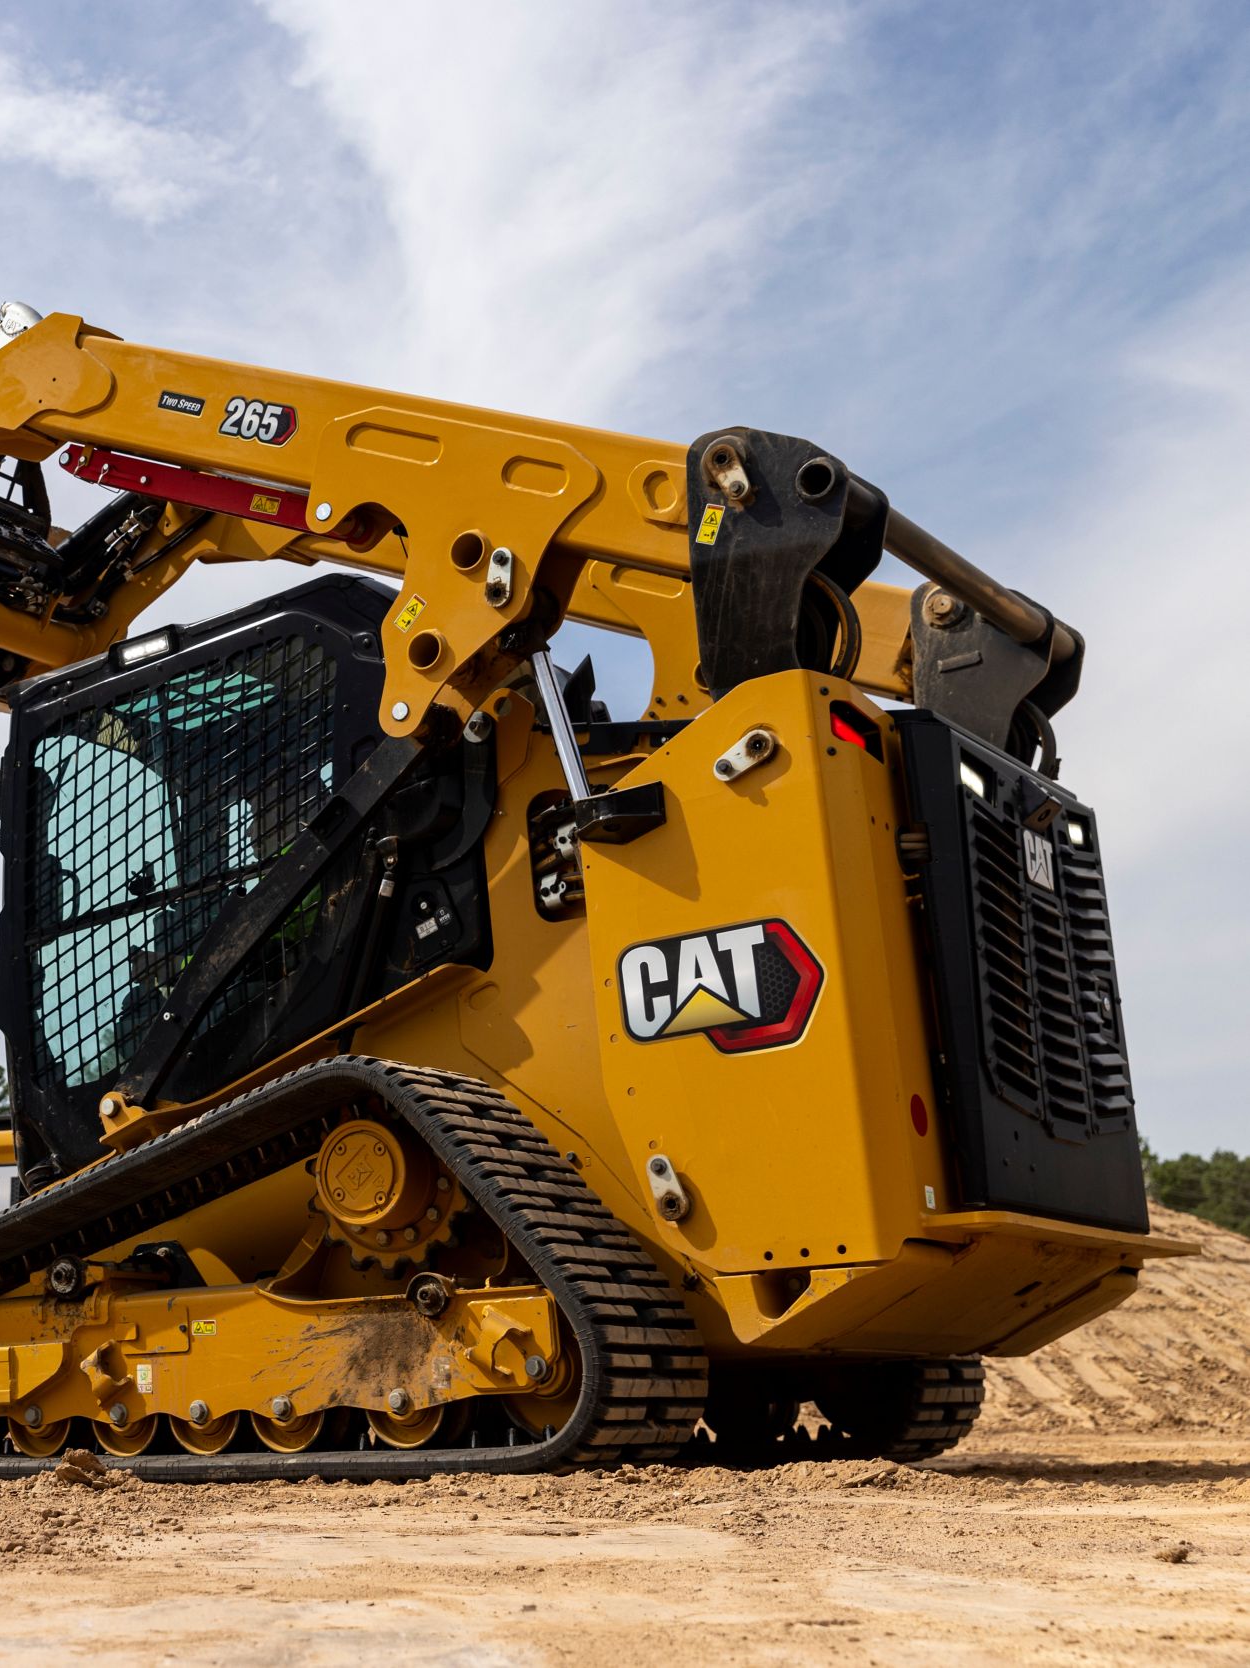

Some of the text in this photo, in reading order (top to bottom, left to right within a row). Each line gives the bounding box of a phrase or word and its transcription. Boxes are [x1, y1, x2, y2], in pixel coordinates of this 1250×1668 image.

[221, 398, 282, 441] 265
[1023, 830, 1054, 890] CAT
[621, 924, 764, 1037] CAT
